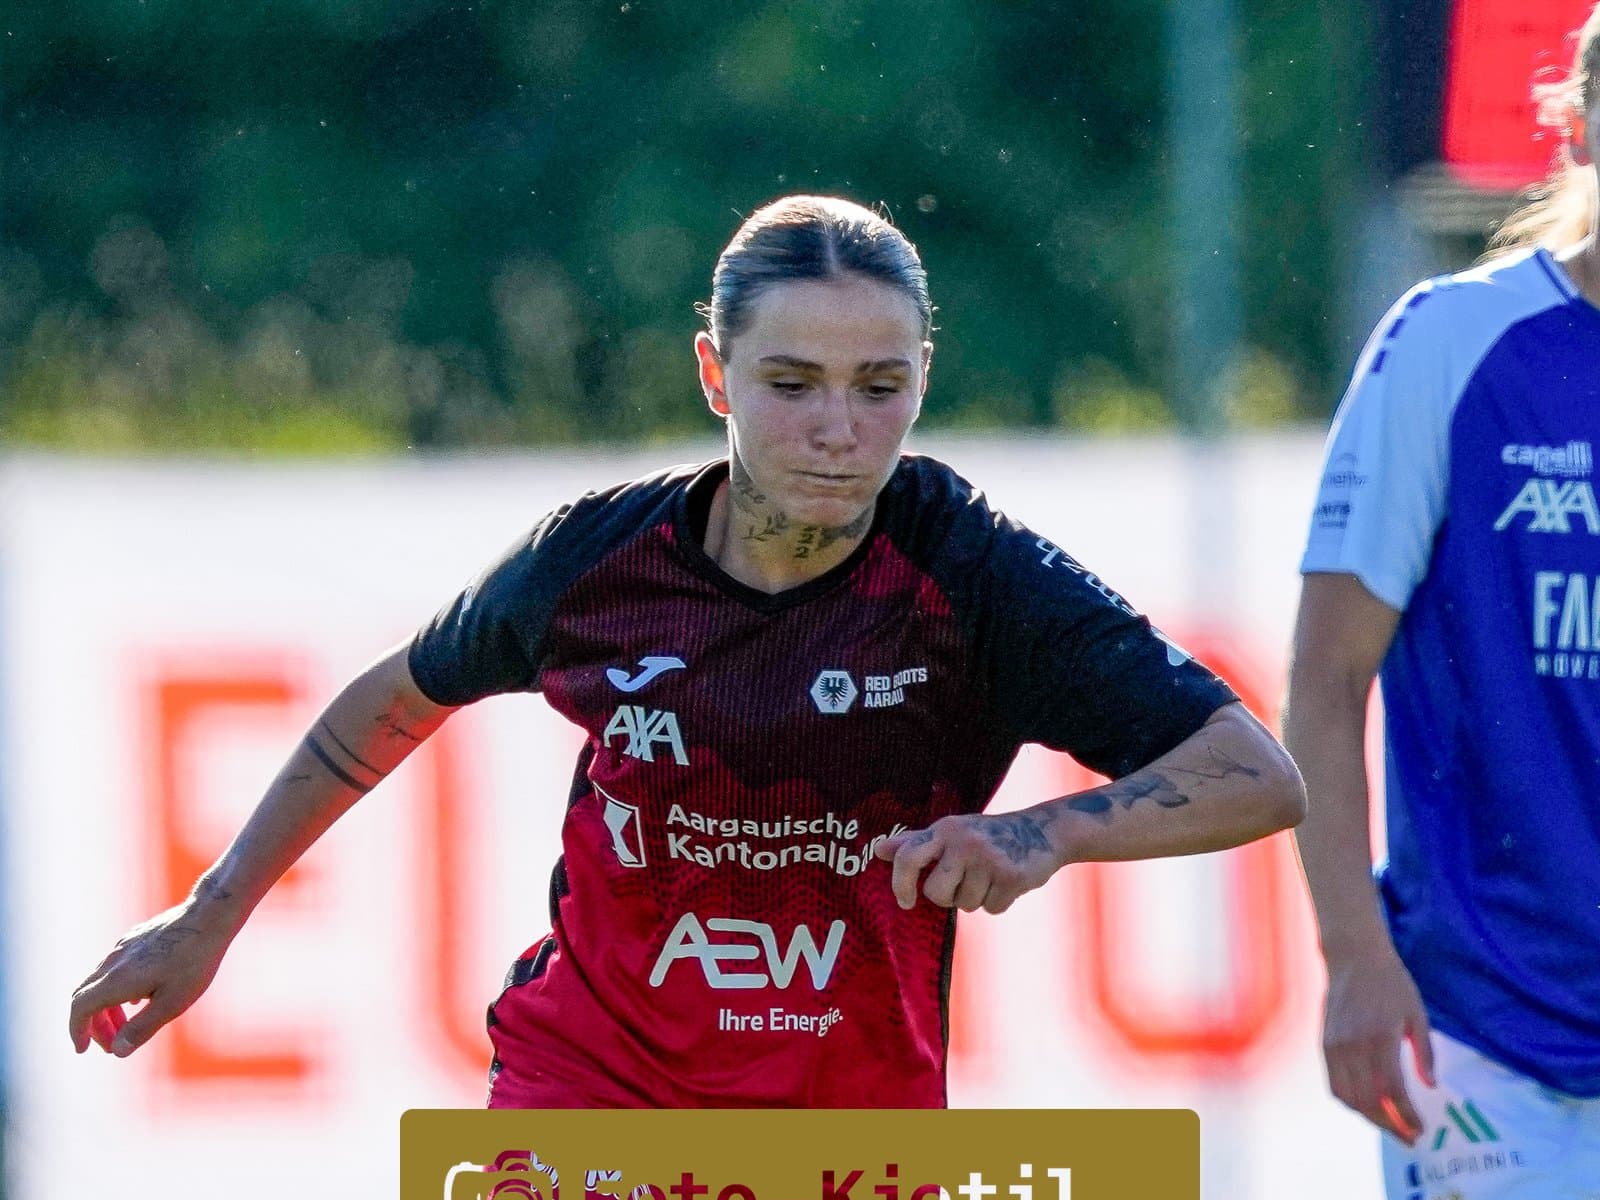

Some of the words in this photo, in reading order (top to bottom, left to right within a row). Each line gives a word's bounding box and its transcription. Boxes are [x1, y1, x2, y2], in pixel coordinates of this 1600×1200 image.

[1494, 479, 1600, 534] AXA
[864, 676, 891, 692] RED
[893, 667, 928, 689] BOOTS
[864, 687, 904, 708] AARAU
[603, 705, 690, 766] AXA
[666, 804, 858, 840] Aargauische
[649, 912, 846, 990] AEW
[719, 1008, 764, 1031] Ihre
[769, 1007, 844, 1037] Energie.
